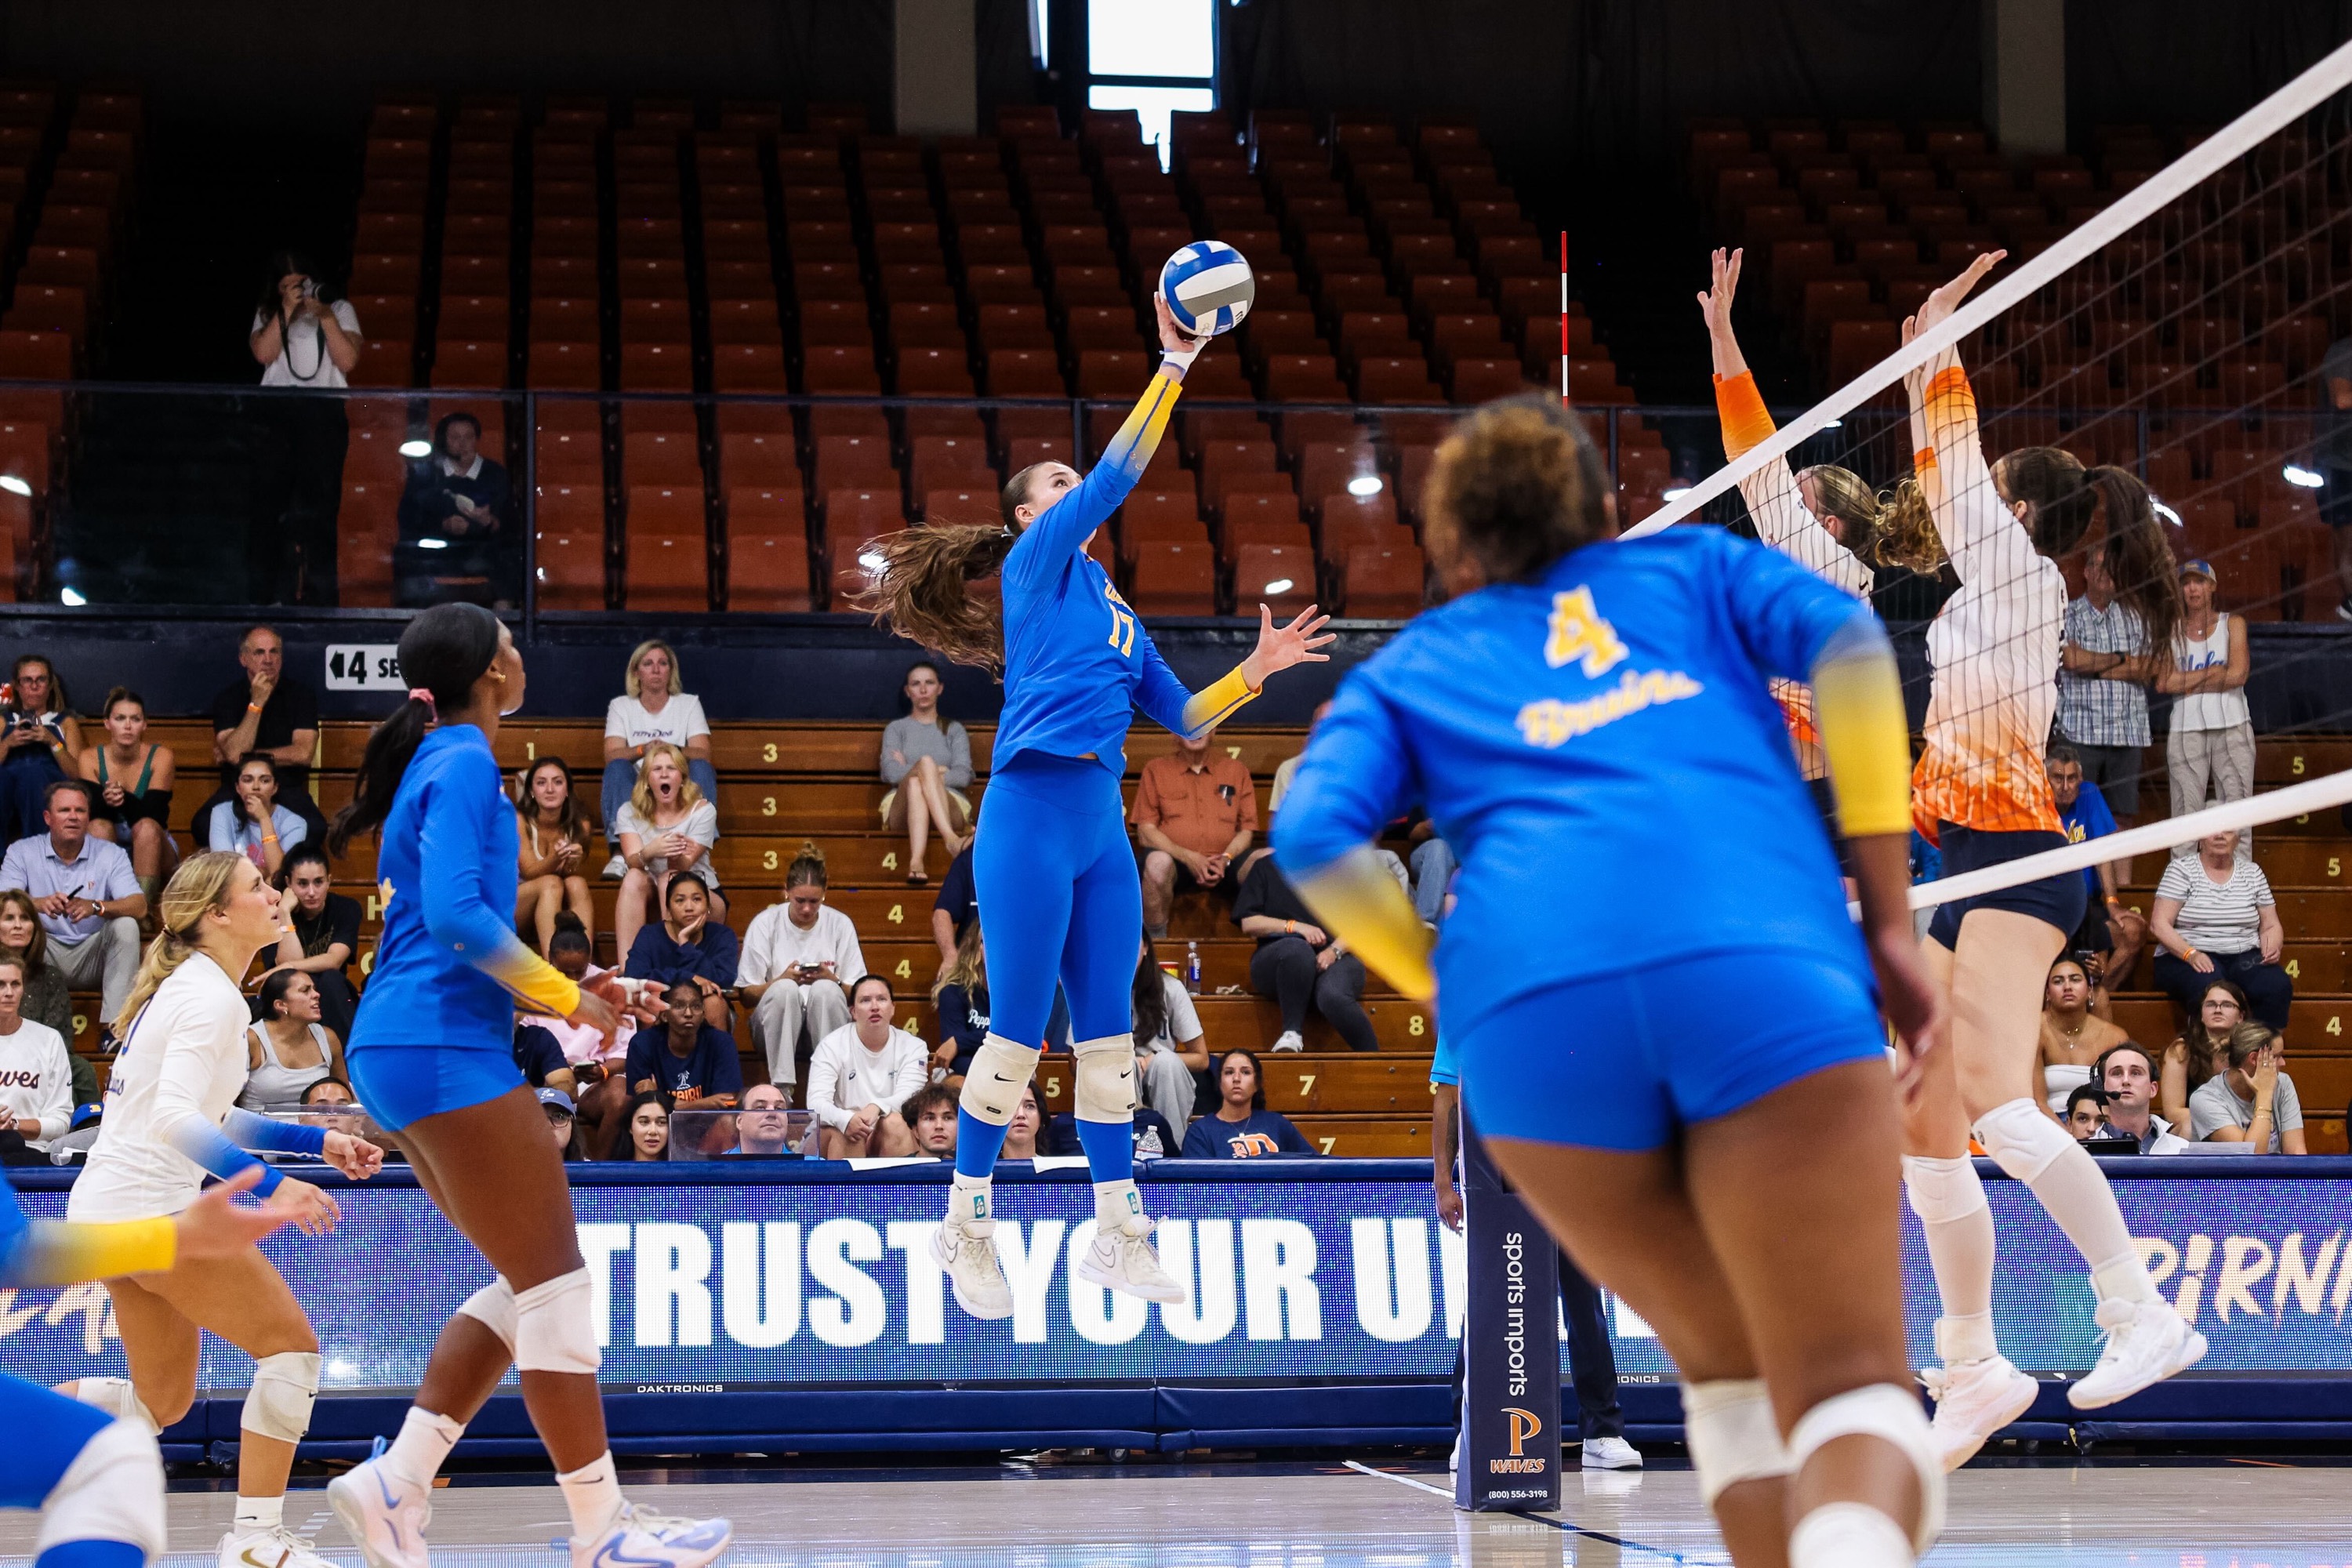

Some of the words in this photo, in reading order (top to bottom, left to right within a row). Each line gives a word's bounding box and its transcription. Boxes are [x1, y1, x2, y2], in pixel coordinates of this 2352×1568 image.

[1544, 585, 1630, 680] 4
[348, 651, 368, 684] 4
[378, 658, 400, 678] SE
[526, 742, 535, 760] 1
[763, 742, 779, 763] 3
[2292, 756, 2305, 775] 5
[762, 797, 777, 816] 3
[763, 850, 779, 869] 3
[881, 852, 898, 870] 4
[2327, 857, 2341, 877] 5
[887, 905, 904, 924] 4
[895, 959, 912, 978] 4
[2285, 959, 2300, 978] 4
[71, 1014, 88, 1035] 9
[902, 1017, 920, 1036] 4
[967, 1008, 990, 1029] Pepp
[1409, 1015, 1425, 1036] 8
[2325, 1016, 2343, 1036] 4
[1045, 1077, 1061, 1098] 5
[1299, 1075, 1316, 1096] 7
[1319, 1138, 1337, 1156] 7
[1503, 1232, 1526, 1304] sports
[575, 1218, 945, 1348] TRUST
[994, 1217, 1323, 1346] YOUR
[637, 1385, 724, 1393] DAKTRONICS
[1501, 1407, 1542, 1457] P
[1490, 1458, 1546, 1474] WAVES
[1488, 1490, 1510, 1499] (800)
[1511, 1490, 1548, 1498] 556-3198
